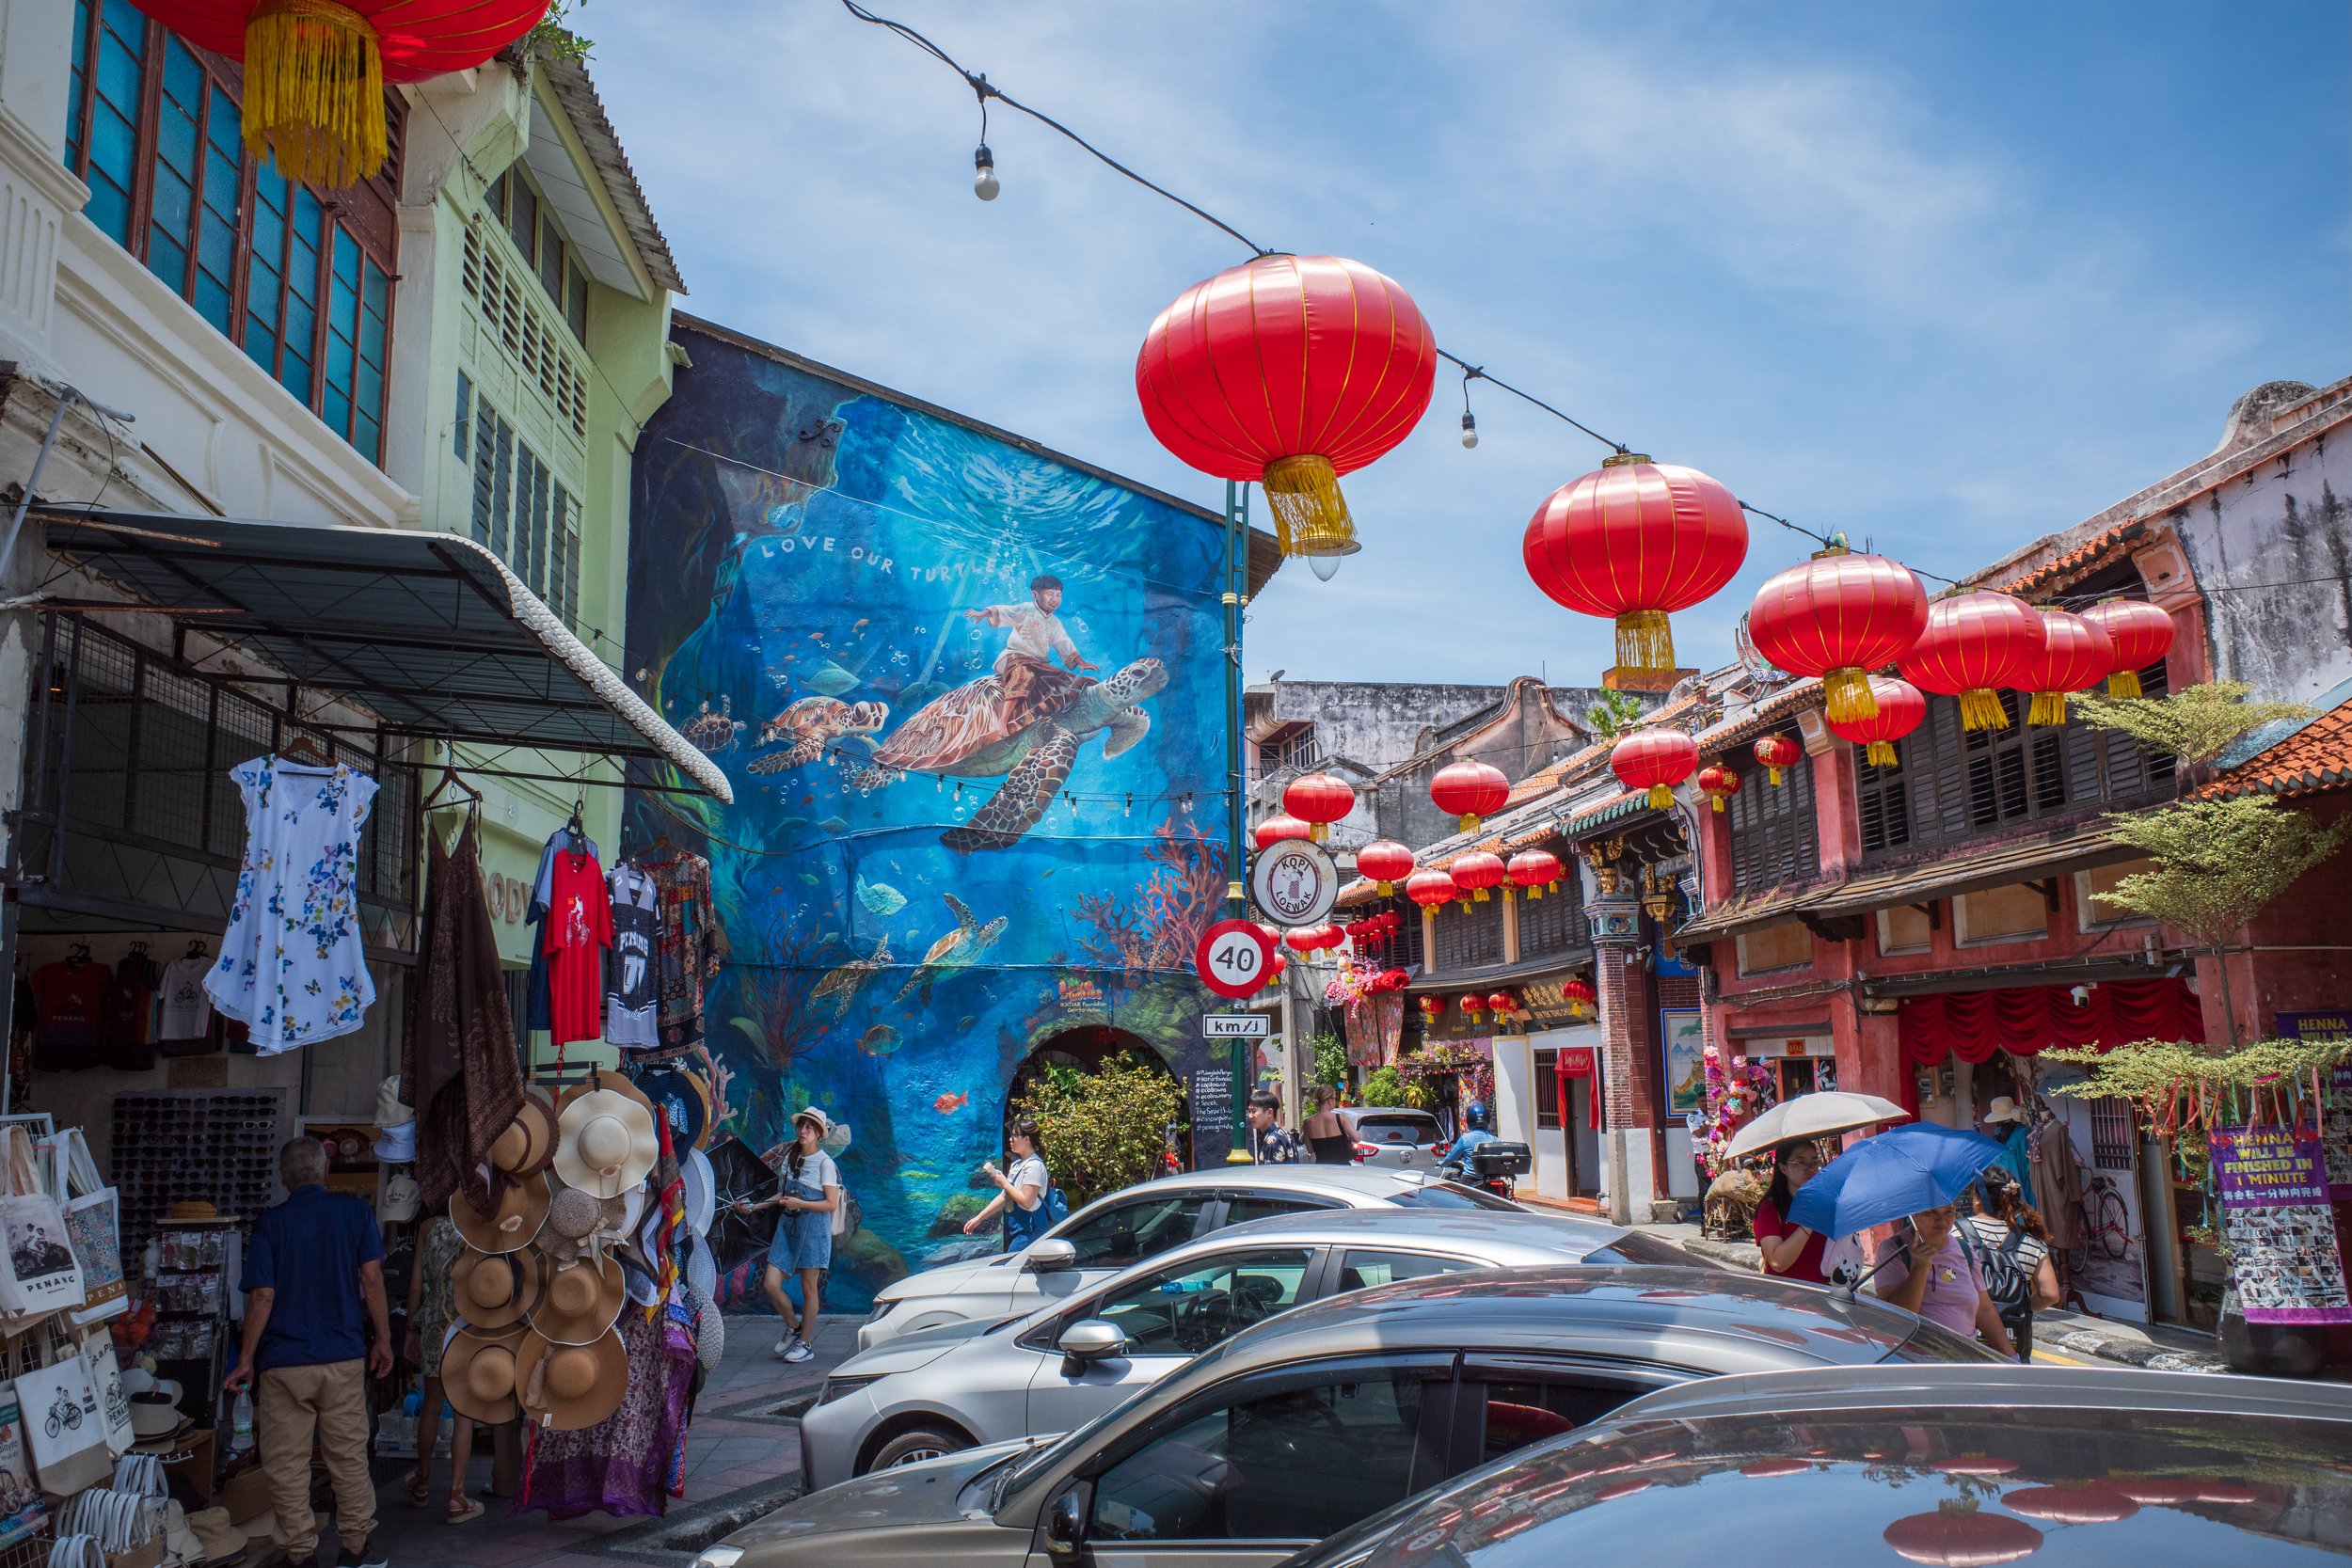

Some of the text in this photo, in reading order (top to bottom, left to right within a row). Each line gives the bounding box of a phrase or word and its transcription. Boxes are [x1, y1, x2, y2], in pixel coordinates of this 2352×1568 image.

[761, 536, 1013, 582] LOVE OUR TURTLES
[1281, 857, 1311, 871] KOPI
[1276, 890, 1311, 912] LOEWAK
[1216, 946, 1255, 973] 40
[2297, 1018, 2348, 1031] HENNA
[2233, 1132, 2296, 1147] HENNA
[2236, 1146, 2296, 1160] WILL BE
[2223, 1158, 2312, 1174] FINISHED IN
[2236, 1171, 2307, 1185] 1 MINUTE
[2222, 1186, 2323, 1200] 将会在一分钟内完成
[26, 1275, 75, 1292] PENANG
